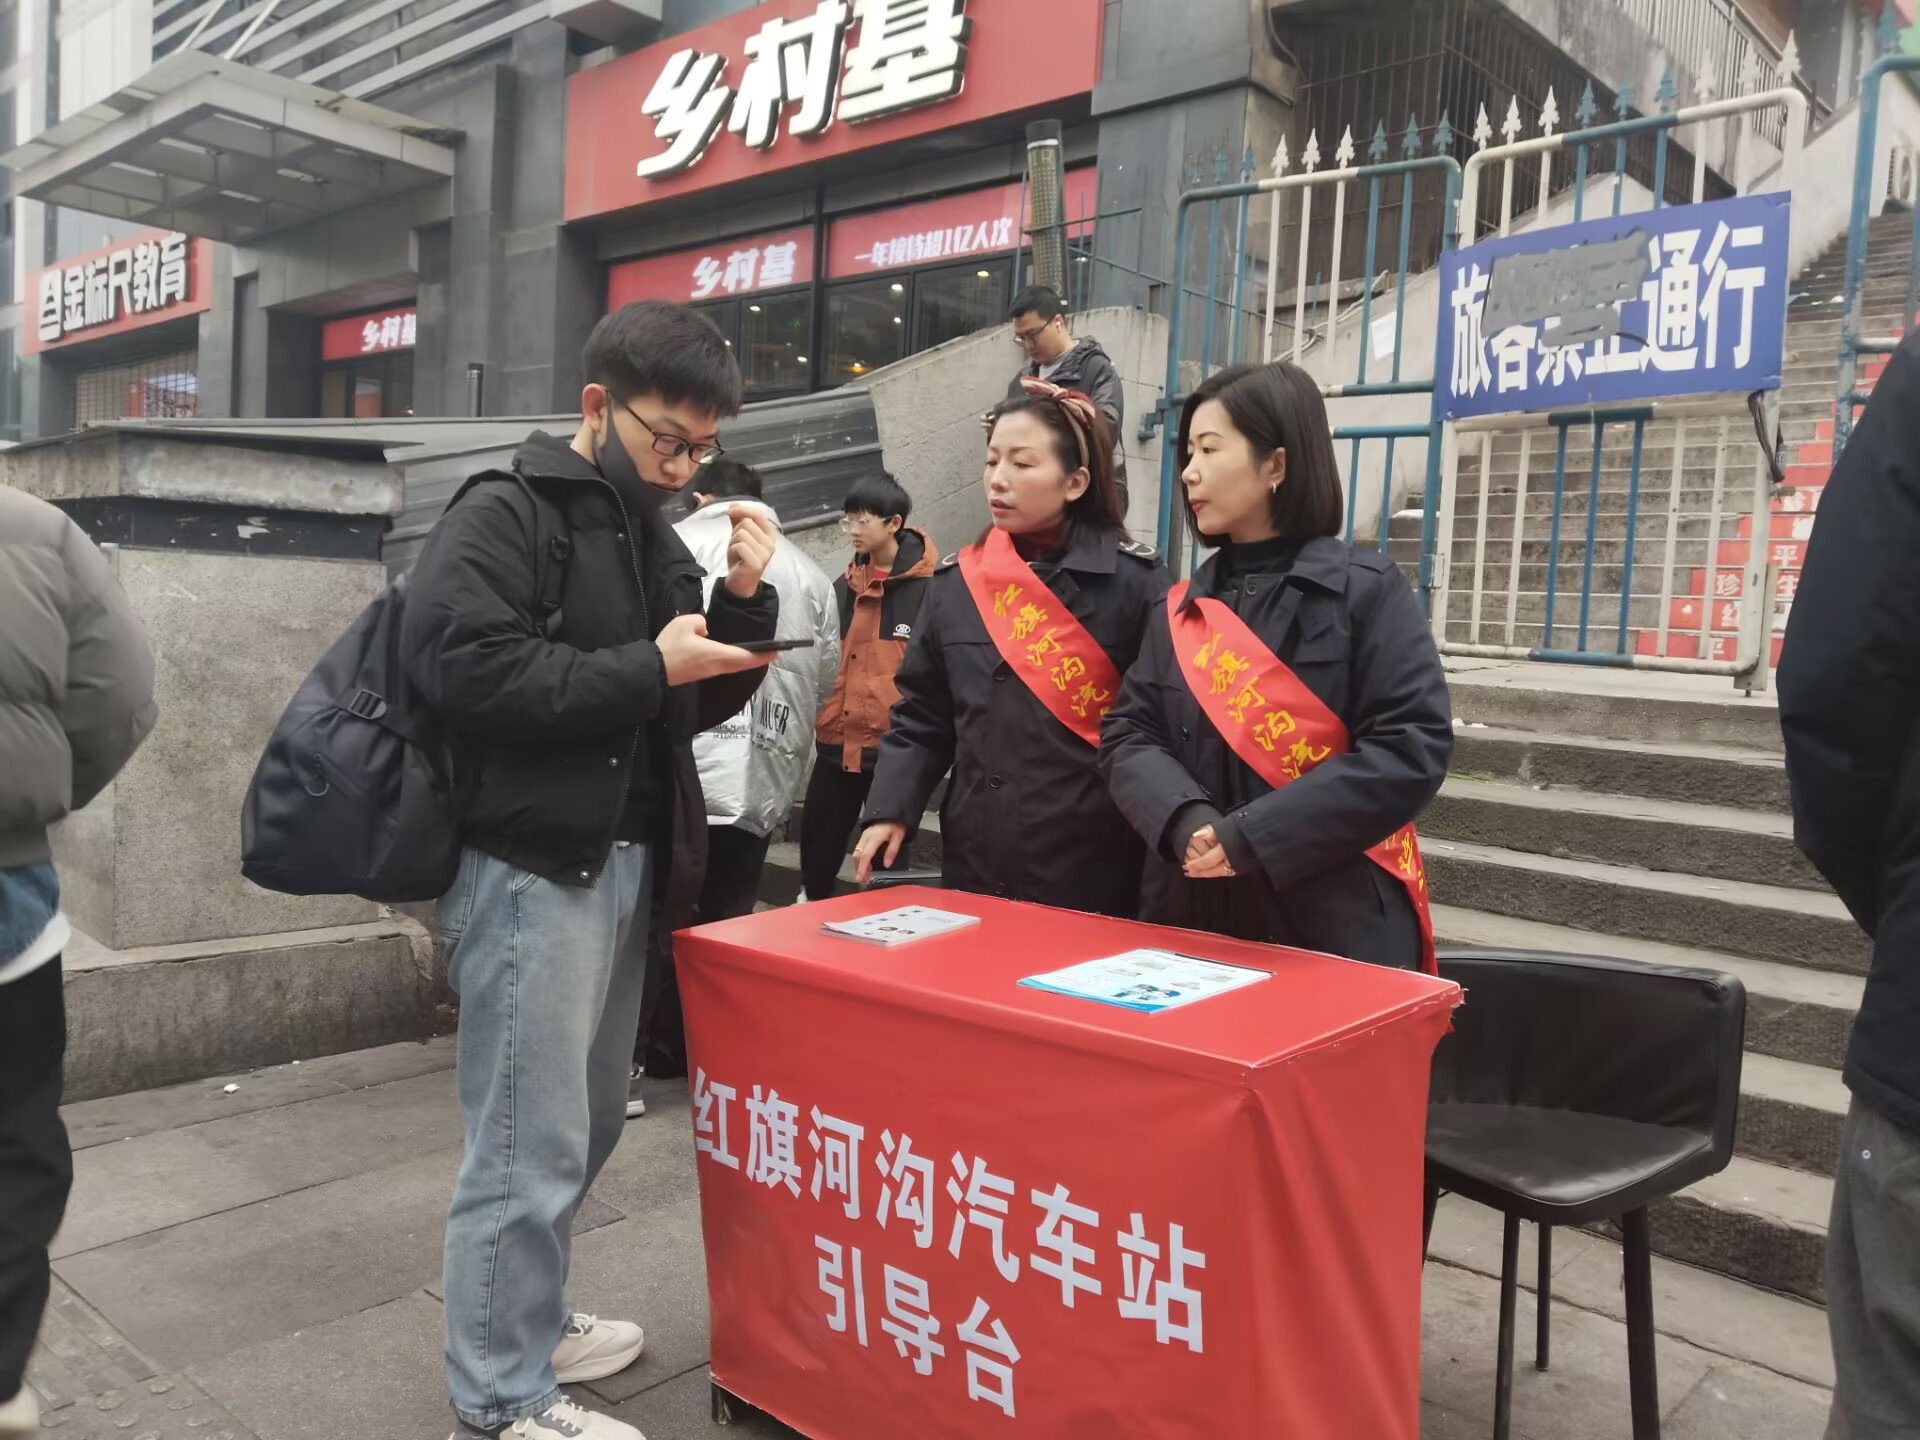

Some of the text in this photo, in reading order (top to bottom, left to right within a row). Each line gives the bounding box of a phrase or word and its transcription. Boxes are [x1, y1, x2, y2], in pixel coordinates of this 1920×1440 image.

[636, 0, 969, 178] 乡村基
[63, 231, 187, 331] 金标尺教育
[690, 241, 797, 299] 乡村基
[993, 583, 1112, 717] 红旗河沟汽
[693, 1067, 1206, 1354] 红旗河沟汽车站
[814, 1234, 1022, 1418] 引导台
